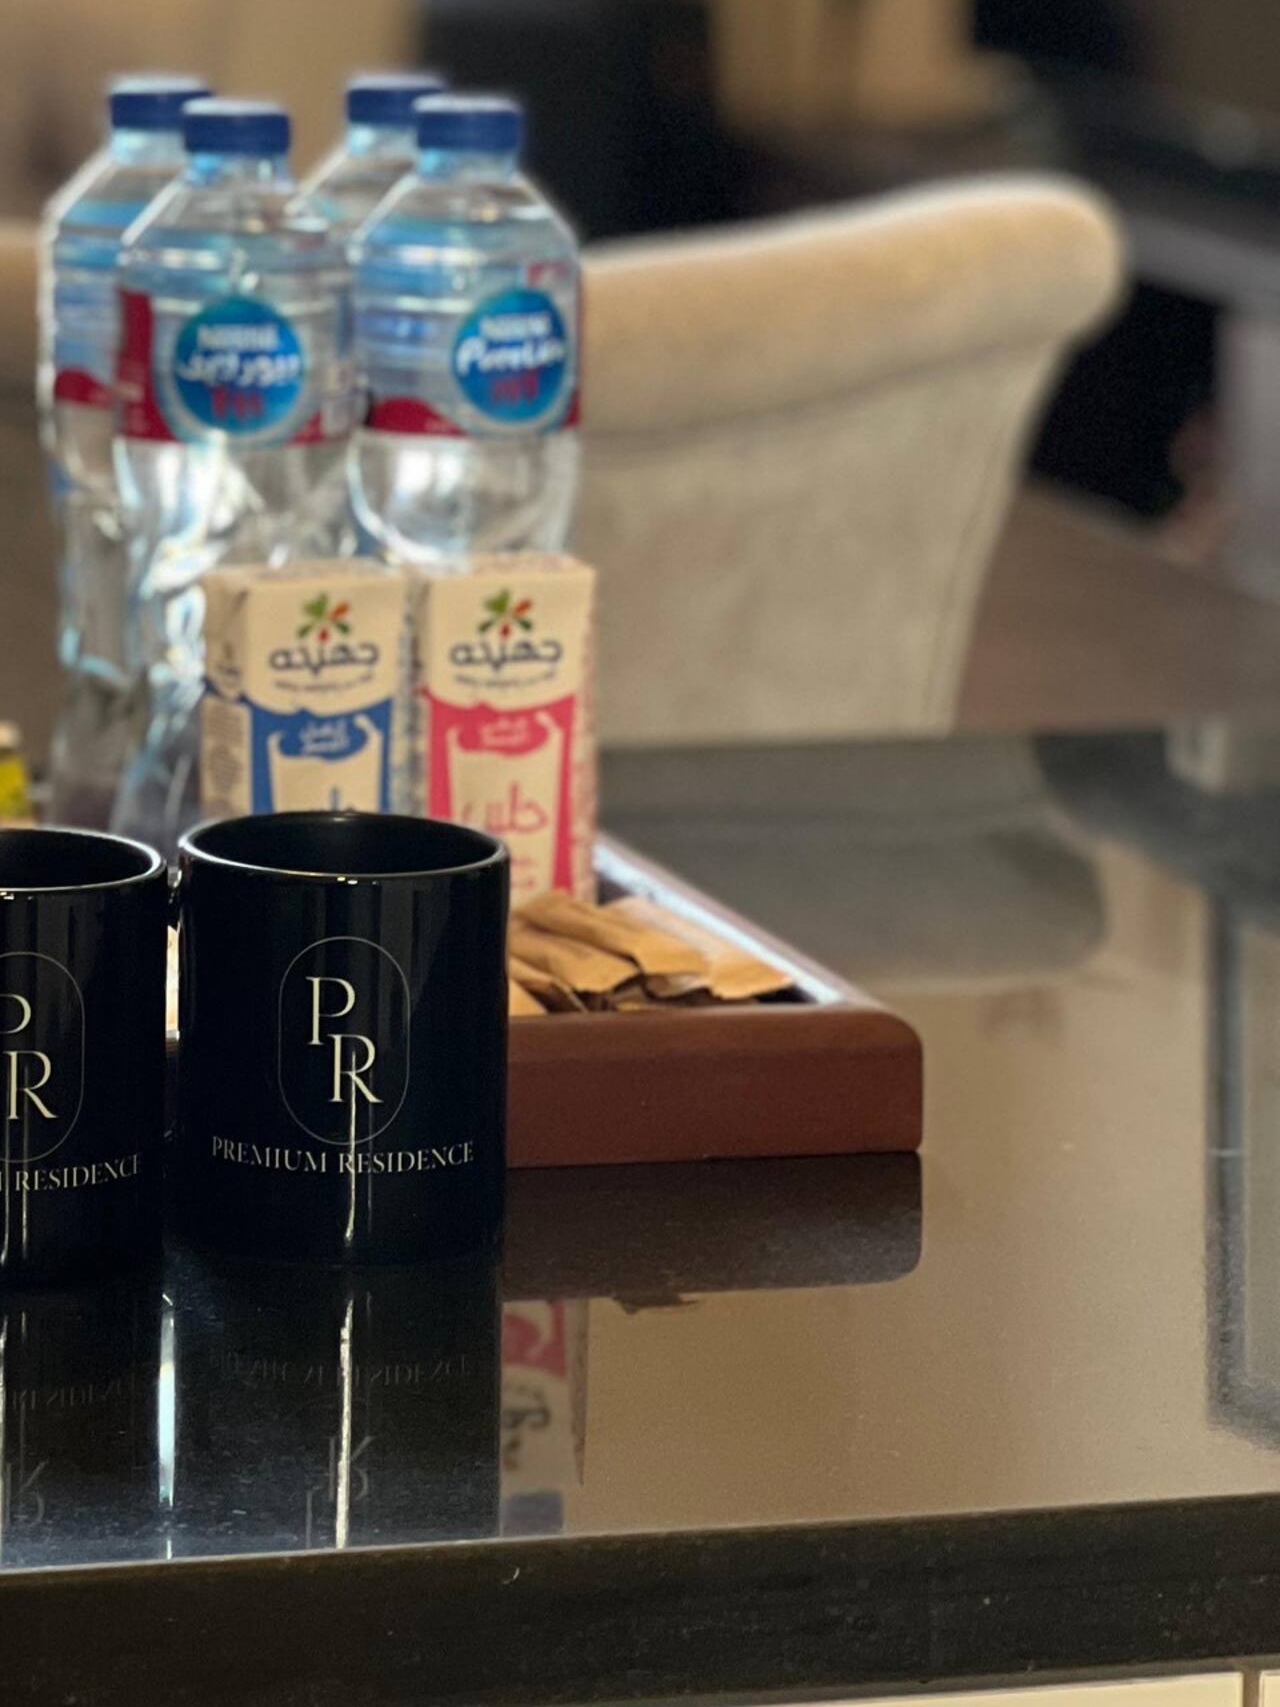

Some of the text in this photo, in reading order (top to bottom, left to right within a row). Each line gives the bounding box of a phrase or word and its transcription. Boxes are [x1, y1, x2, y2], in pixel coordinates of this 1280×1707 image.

[15, 1151, 143, 1192] RESIDENCE
[211, 1135, 475, 1175] PREMIUM RESIDENCE
